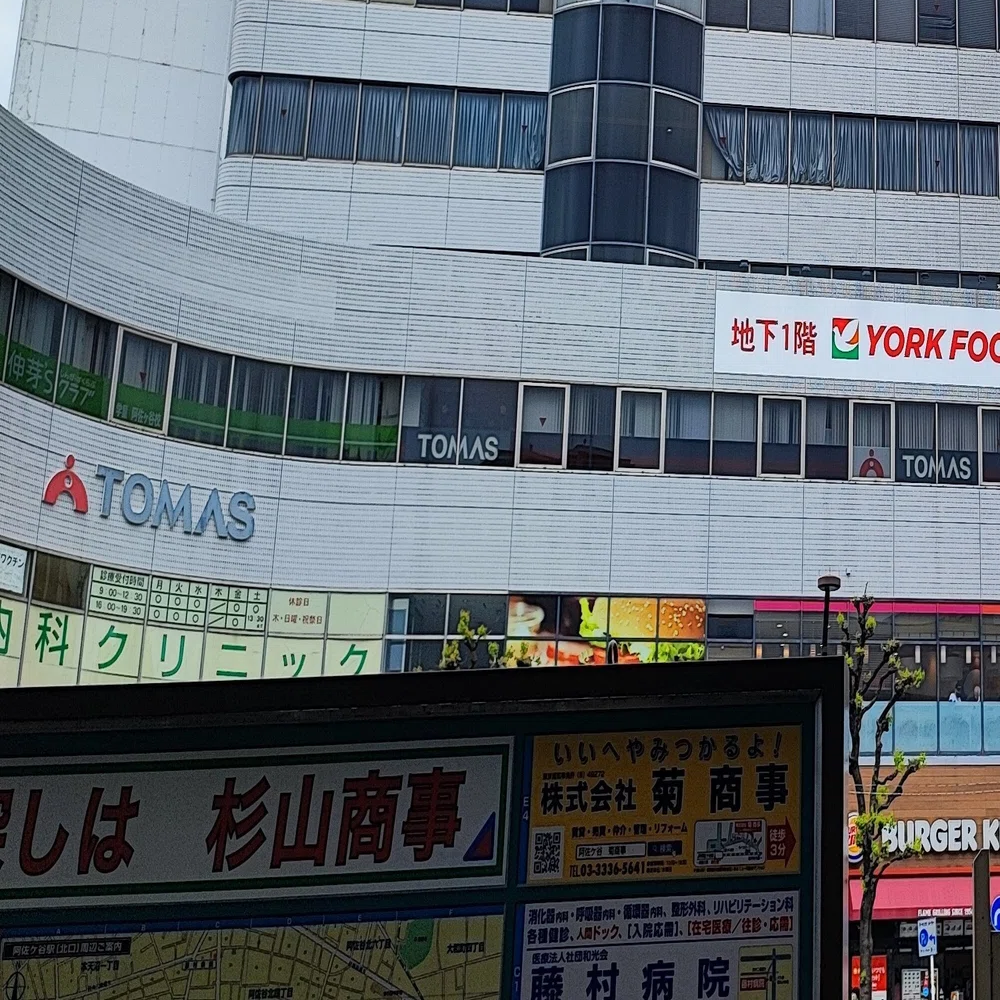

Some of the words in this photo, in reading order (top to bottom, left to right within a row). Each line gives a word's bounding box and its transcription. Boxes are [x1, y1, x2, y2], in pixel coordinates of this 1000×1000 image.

[731, 317, 818, 357] 地下1階
[867, 323, 948, 360] YORK
[417, 434, 499, 462] TOMAS
[902, 454, 972, 480] TOMAS
[95, 463, 256, 542] TOMAS
[100, 569, 145, 588] 診療受付時間
[541, 778, 637, 815] 株式会社
[652, 763, 789, 815] 菊商事
[206, 767, 467, 873] 杉山商事
[769, 828, 786, 842] 徒歩
[770, 843, 786, 857] 3分
[880, 819, 977, 853] BURGER
[580, 861, 645, 877] 03-3336-5641
[532, 949, 609, 965] 医療法人社団和光会
[530, 957, 730, 1000] 藤村病院
